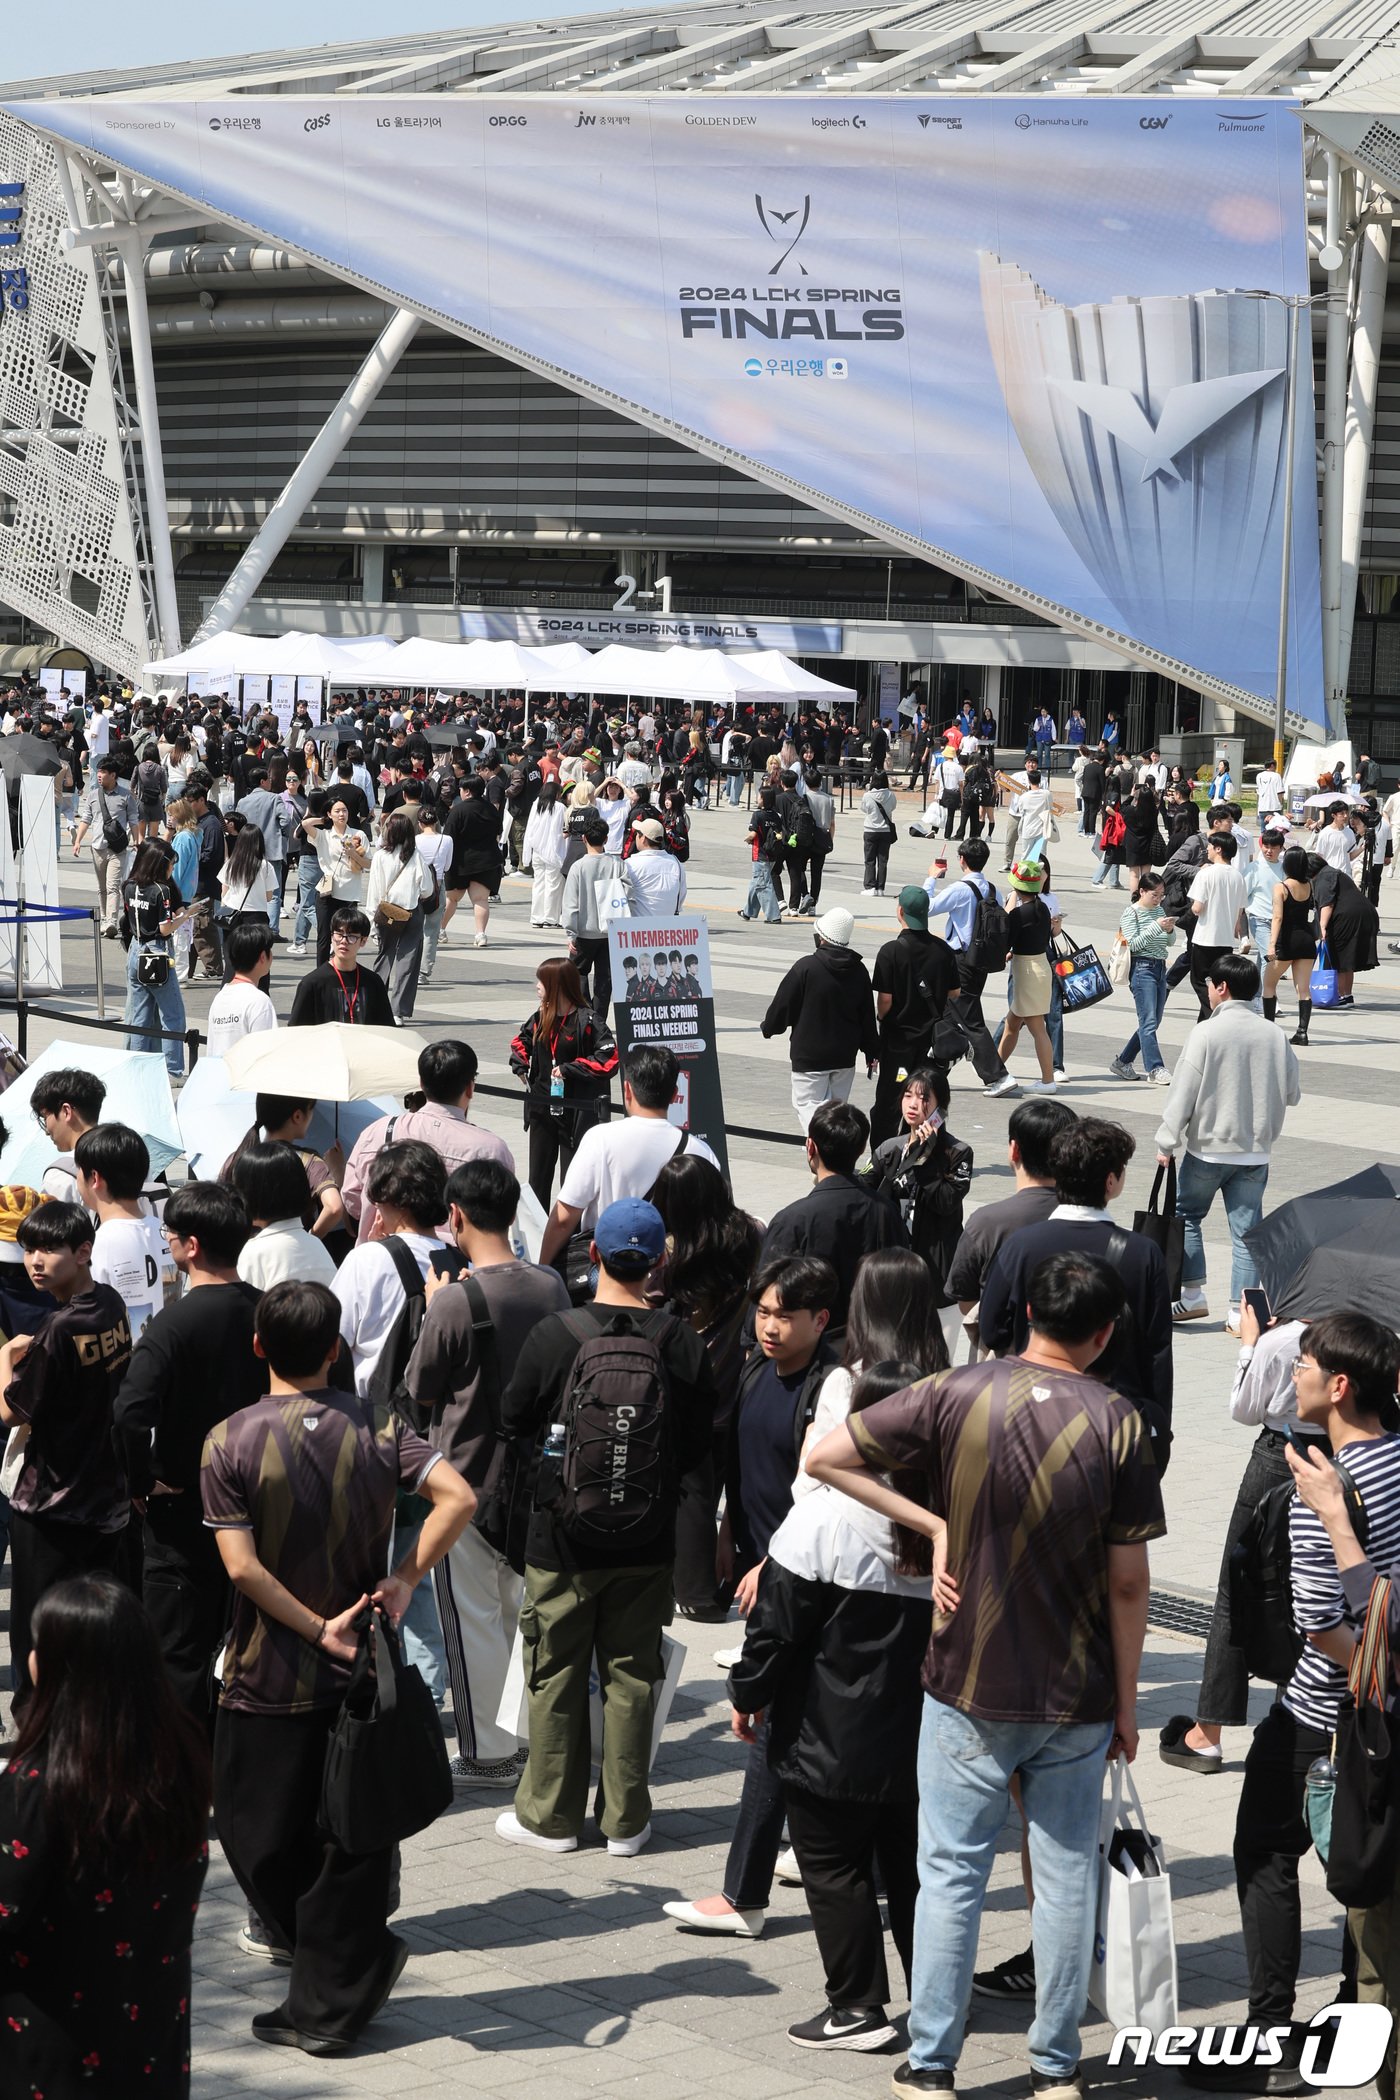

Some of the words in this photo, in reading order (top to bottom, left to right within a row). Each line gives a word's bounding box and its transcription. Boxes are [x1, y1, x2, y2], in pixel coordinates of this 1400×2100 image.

[105, 120, 161, 130] Sponsored
[163, 120, 176, 130] by
[222, 118, 261, 130] 우리은행
[376, 118, 391, 127] LG
[394, 117, 442, 128] 울트라기어
[489, 116, 527, 127] OP.GG
[685, 115, 731, 126] GOLDEN
[732, 116, 758, 126] DEW
[811, 117, 850, 129] logitech
[1033, 118, 1070, 126] Hanwha
[1072, 118, 1089, 126] Life
[1139, 117, 1169, 130] CGV
[1218, 122, 1266, 132] Pulmuone
[679, 287, 747, 301] 2024
[753, 288, 801, 302] LCK
[806, 289, 901, 303] SPRING
[680, 307, 905, 341] FINALS
[765, 359, 824, 377] 우리은행
[612, 574, 672, 613] 2-1
[537, 619, 584, 632] 2024
[587, 620, 622, 634] LCK
[625, 623, 691, 636] SPRING
[693, 625, 758, 638] FINALS
[617, 930, 629, 949] T1
[631, 928, 699, 948] MEMBERSHIP
[630, 1006, 652, 1021] 2024
[654, 1005, 669, 1020] LCK
[670, 1004, 699, 1019] SPRING
[633, 1023, 661, 1038] FINALS
[662, 1021, 699, 1037] WEEKEND
